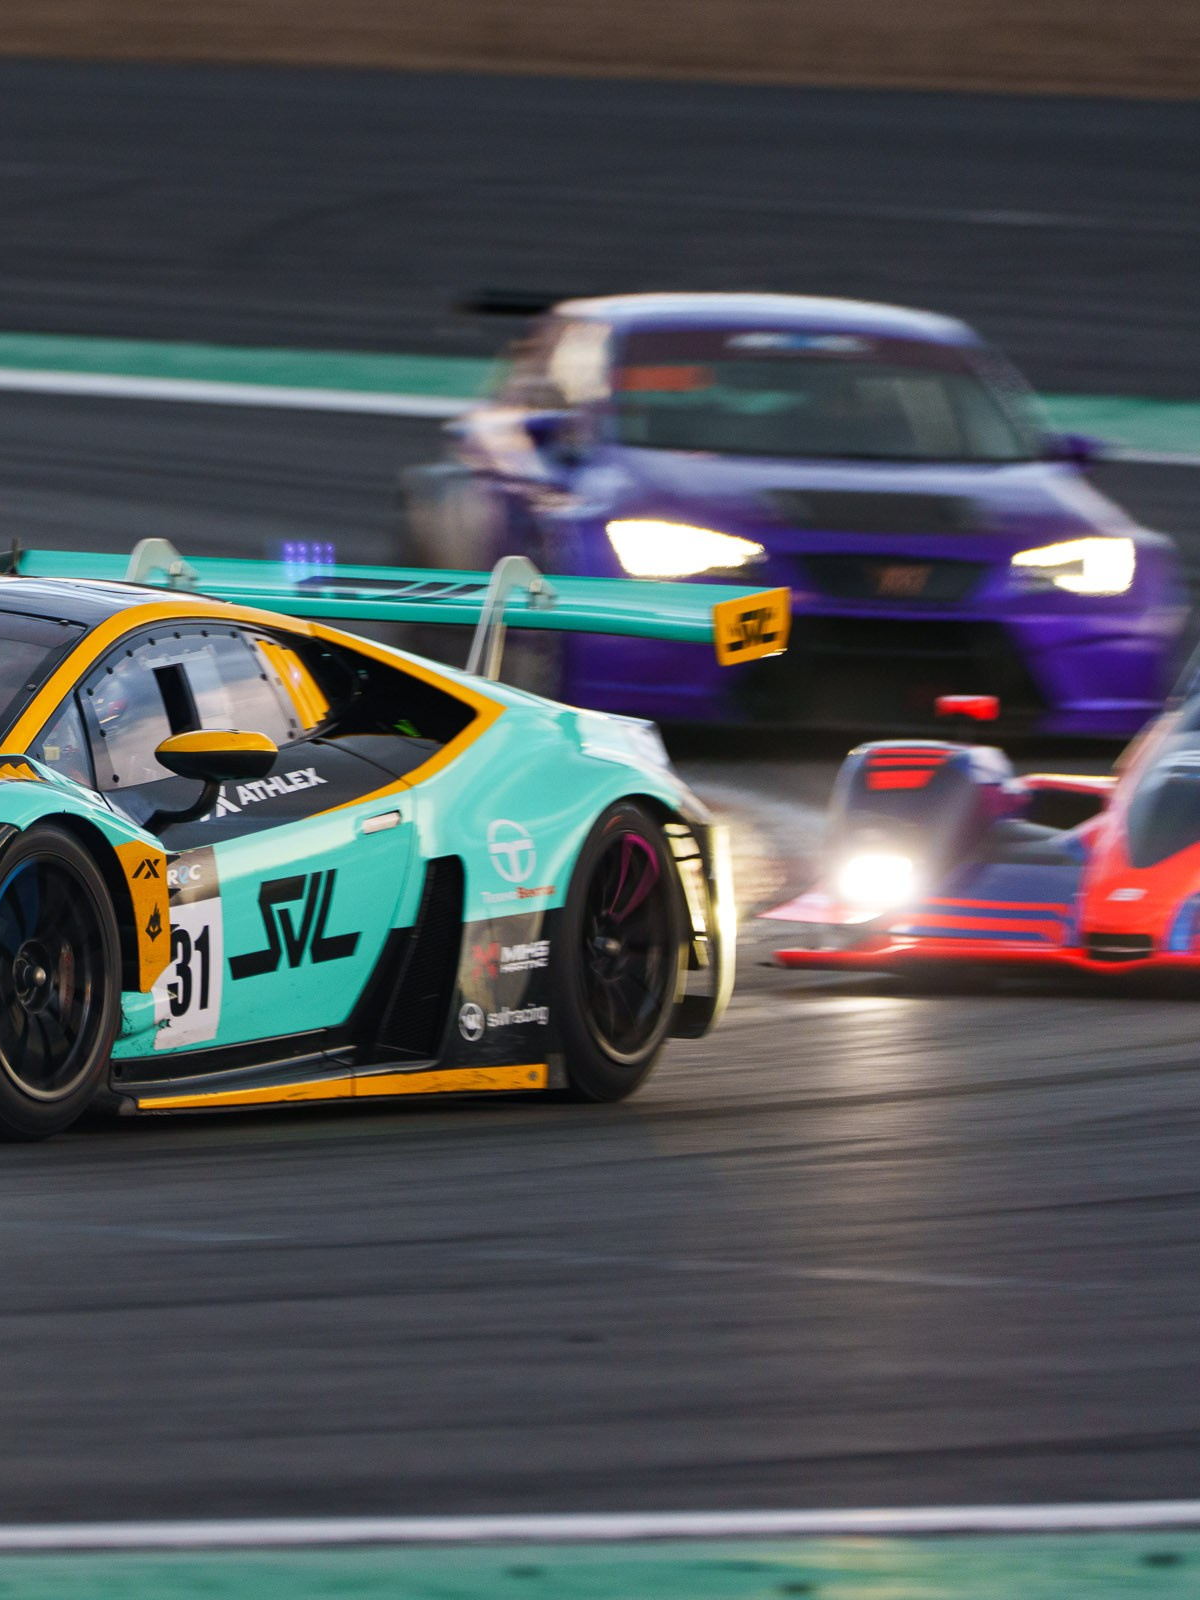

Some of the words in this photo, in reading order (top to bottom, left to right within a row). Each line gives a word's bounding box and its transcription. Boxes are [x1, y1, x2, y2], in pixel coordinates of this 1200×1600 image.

[236, 767, 328, 806] ATHLEX
[227, 868, 363, 981] SVL
[167, 925, 210, 1017] 31
